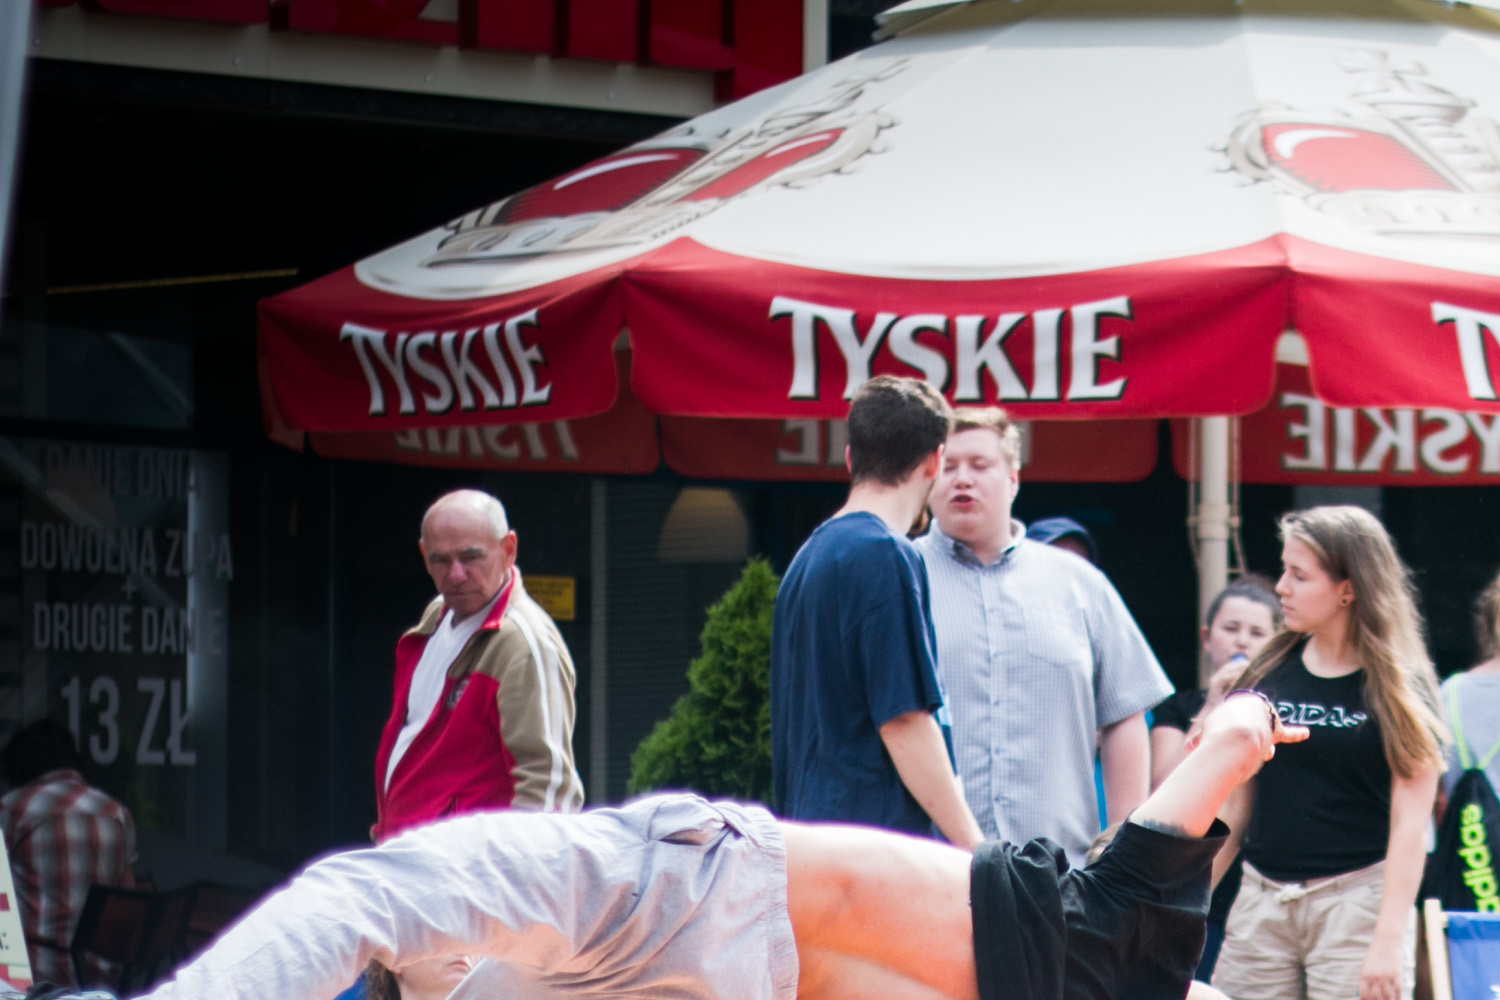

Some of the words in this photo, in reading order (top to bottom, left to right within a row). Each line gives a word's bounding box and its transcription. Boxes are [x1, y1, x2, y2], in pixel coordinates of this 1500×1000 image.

[340, 309, 553, 416] TYSKIE
[769, 296, 1133, 402] TYSKIE
[21, 521, 156, 575] DOWOLNA
[32, 601, 132, 654] DRUGIE
[141, 606, 222, 656] DANE
[60, 675, 120, 765] 13
[136, 678, 197, 766] ZŁ
